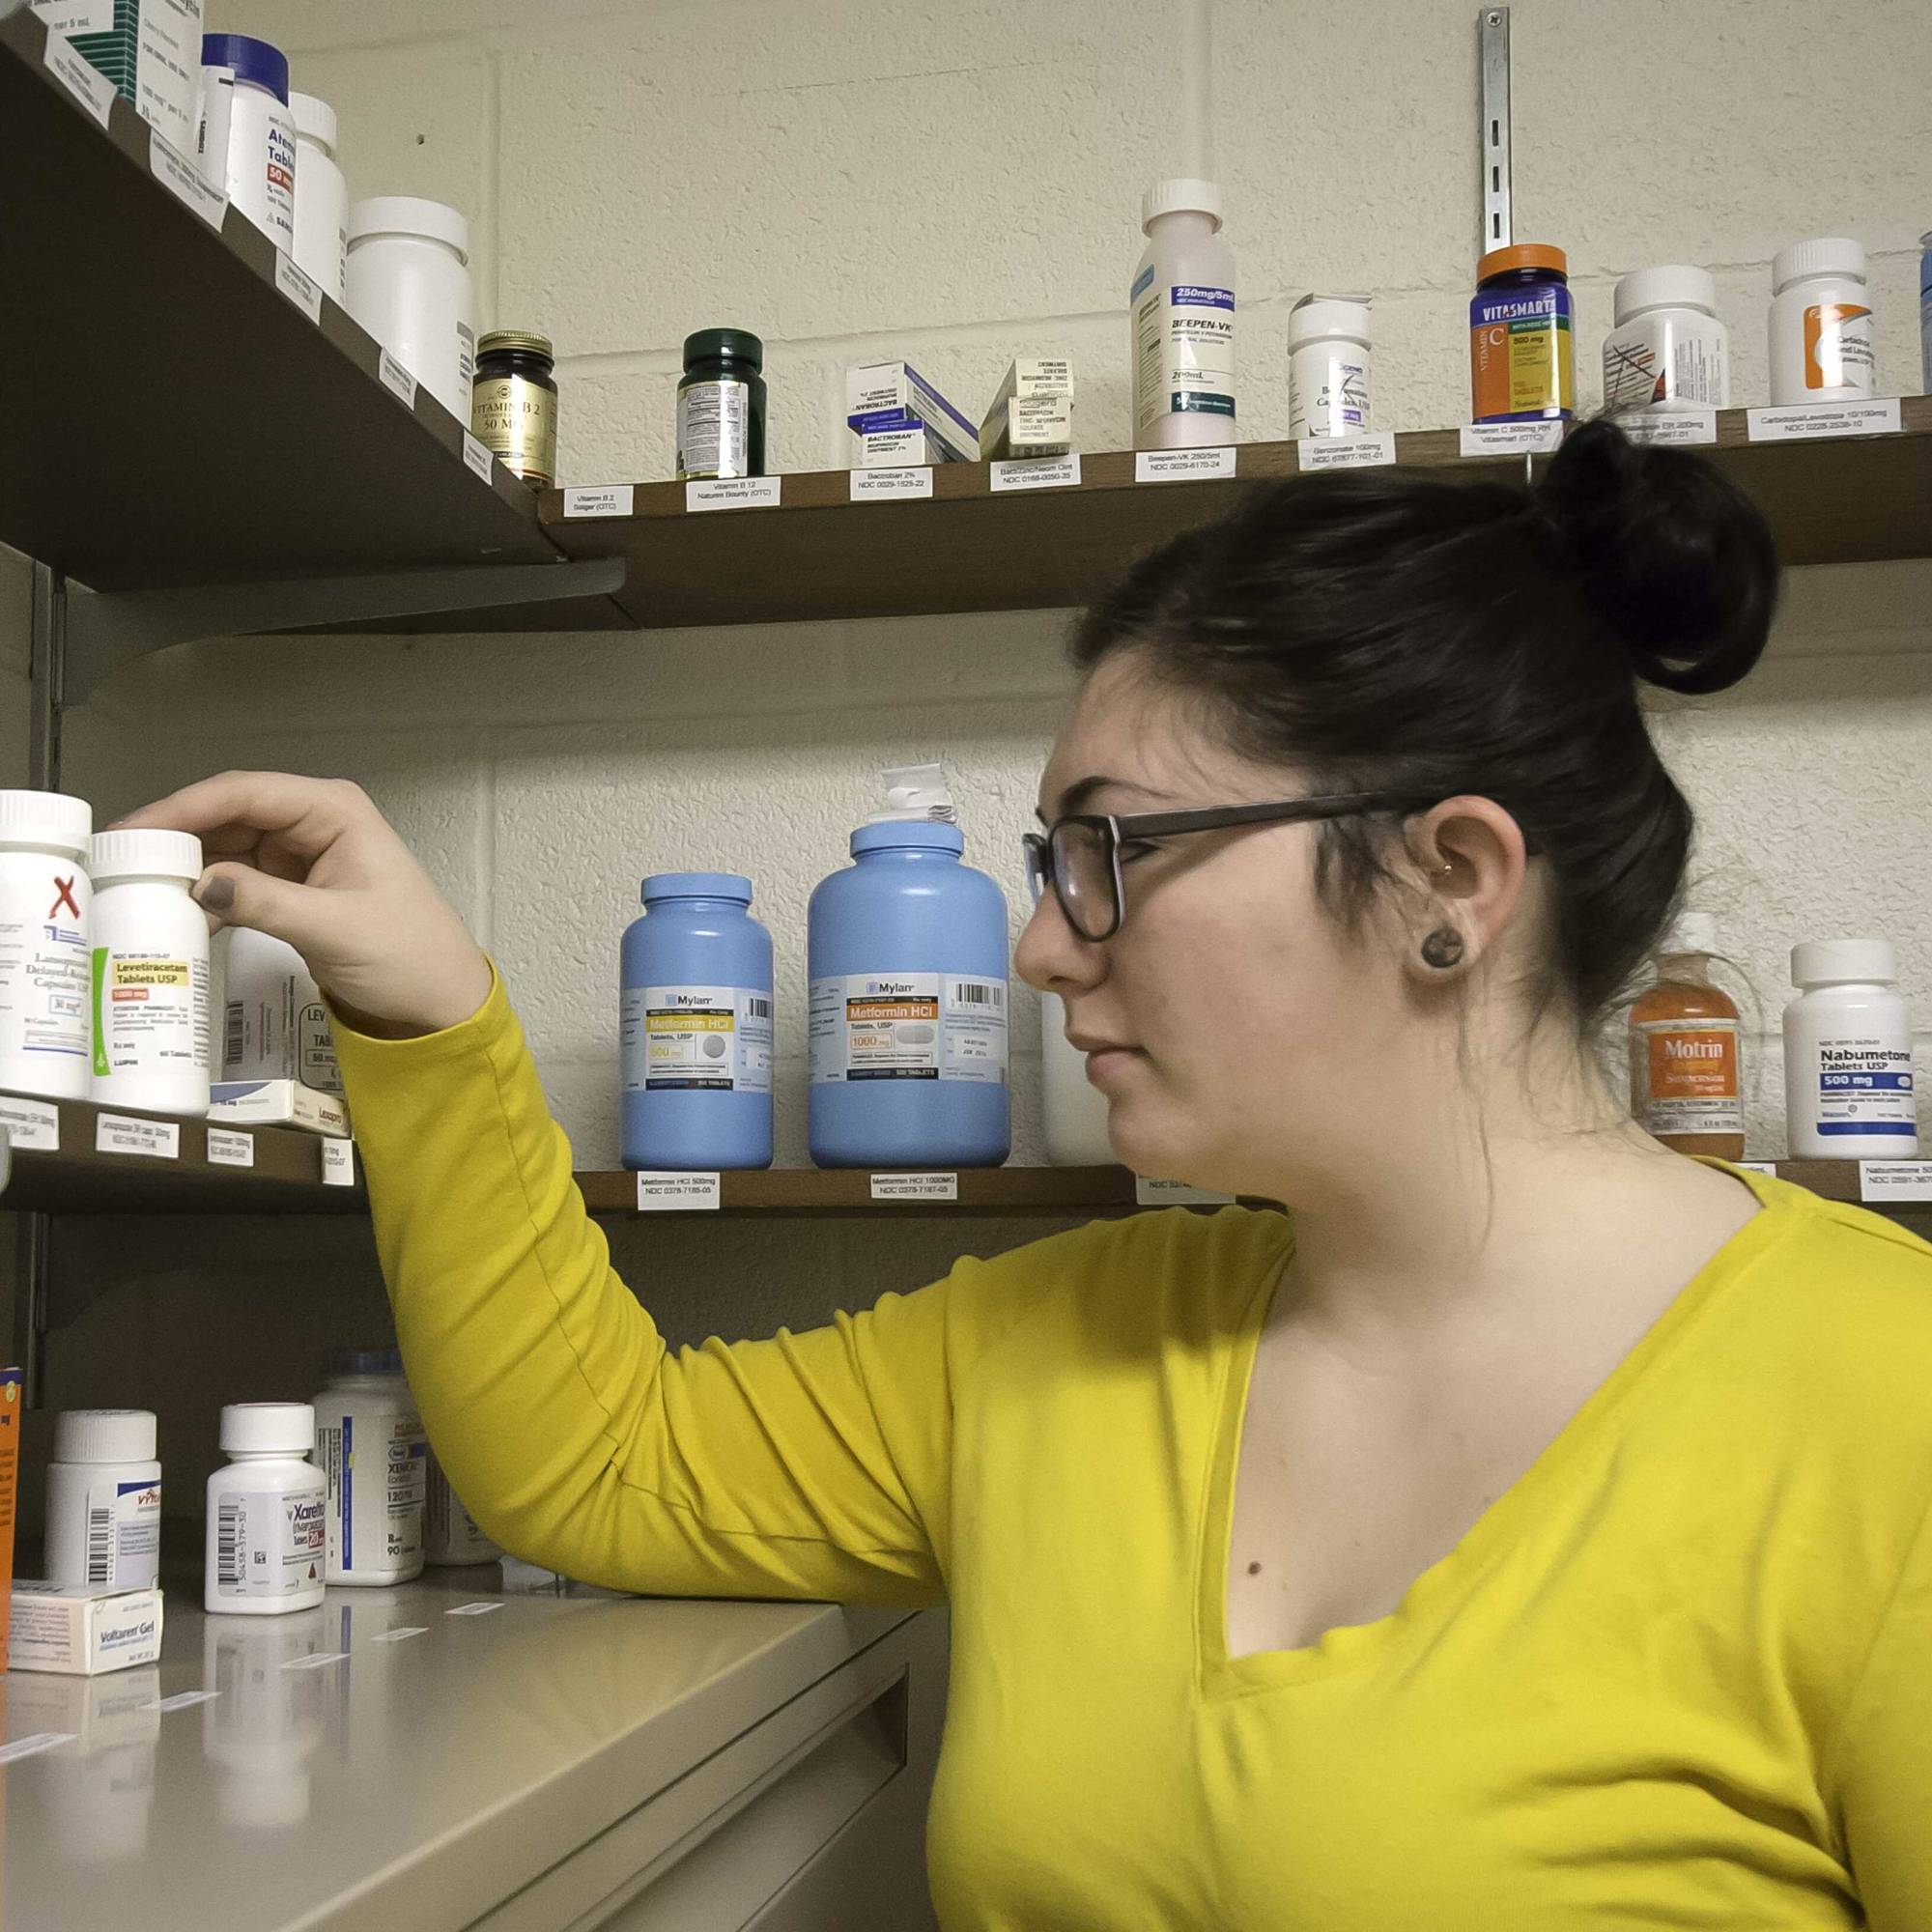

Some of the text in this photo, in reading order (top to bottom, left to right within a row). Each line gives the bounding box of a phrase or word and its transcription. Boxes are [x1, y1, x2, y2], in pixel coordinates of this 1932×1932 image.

[270, 165, 283, 182] 50
[1177, 288, 1235, 302] 250mg/5mL
[1483, 300, 1555, 322] VITASMART
[1172, 319, 1232, 331] BEEPEN-VK
[1489, 328, 1505, 346] C
[1480, 330, 1489, 372] VITAMIN
[523, 401, 531, 412] B
[533, 404, 541, 415] 2
[855, 399, 898, 411] BACTROBAN
[483, 419, 497, 430] 50
[867, 434, 912, 442] BACTROBAN
[1312, 455, 1329, 464] NDC
[117, 962, 188, 973] Levetiracetam
[117, 974, 179, 983] Tablets USP
[879, 982, 912, 994] Mylan
[678, 995, 711, 1007] Mylan
[850, 1006, 932, 1018] Metformin HCl
[650, 1018, 728, 1030] Metformin HCl
[877, 1021, 894, 1030] USP
[853, 1037, 877, 1047] 1000
[1665, 1038, 1723, 1060] Motrin
[1821, 1049, 1911, 1063] Nabumetone
[1821, 1062, 1889, 1071] Tablets USP
[1824, 1075, 1873, 1087] 500 mg
[692, 1178, 715, 1186] 500mg
[1868, 1176, 1890, 1184] NDC
[294, 1500, 325, 1520] Xarelto
[309, 1532, 319, 1546] 20
[239, 1511, 247, 1580] 50458-579-30
[387, 1546, 401, 1556] 90
[139, 1620, 155, 1635] Gel
